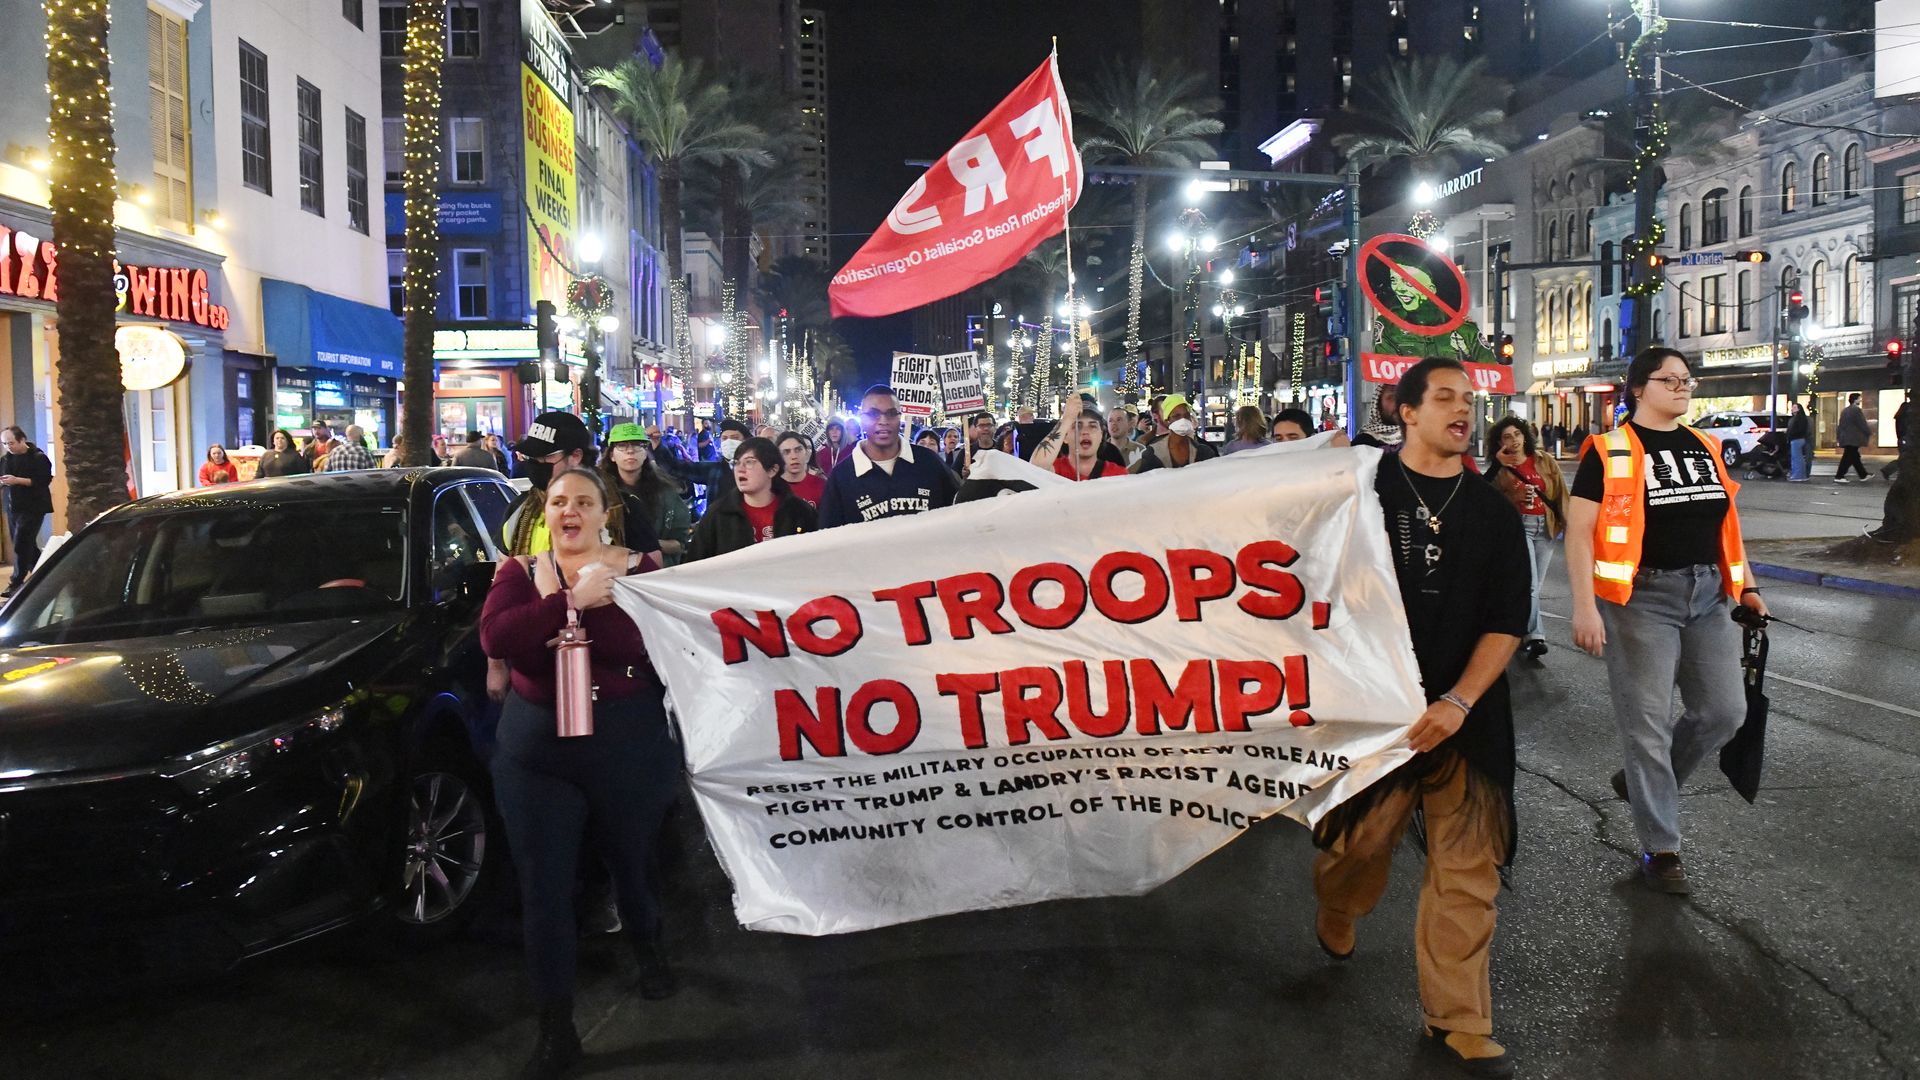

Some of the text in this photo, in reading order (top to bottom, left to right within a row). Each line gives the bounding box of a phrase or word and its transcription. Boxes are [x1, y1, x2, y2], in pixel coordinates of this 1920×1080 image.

[527, 38, 569, 103] JEWELRY
[526, 75, 560, 134] GOING
[526, 107, 573, 176] BUSINESS
[539, 158, 567, 201] FINAL
[1434, 167, 1483, 200] MARRIOTT
[535, 184, 571, 231] WEEKS!
[1686, 252, 1722, 265] St Charles
[127, 264, 208, 326] WING
[317, 351, 393, 371] TOURIST INFORMATION MAPS
[893, 371, 934, 386] TRUMP'S
[898, 356, 931, 373] FIGHT
[941, 368, 979, 383] TRUMP'S
[944, 355, 973, 371] FIGHT
[1369, 359, 1501, 388] LOC UP
[945, 384, 981, 400] AGENDA
[861, 498, 929, 522] NEW STYLE
[1649, 492, 1727, 506] ORGANIZING CONFERENCE
[711, 540, 1331, 665] NO TROOPS,
[774, 655, 1316, 761] NO TRUMP!
[746, 779, 826, 797] RESIST
[833, 774, 876, 788] THE
[883, 757, 985, 783] MILITARY
[994, 747, 1136, 768] OCCUPATION
[1144, 747, 1174, 756] OF
[1243, 745, 1351, 771] ORLEANS
[765, 766, 1313, 816] FIGHT TRUMP & LANDRY'S RACIST AGEND
[769, 818, 926, 849] COMMUNITY
[936, 803, 1063, 830] CONTROL
[1069, 796, 1103, 814] OF
[1111, 795, 1162, 814] THE
